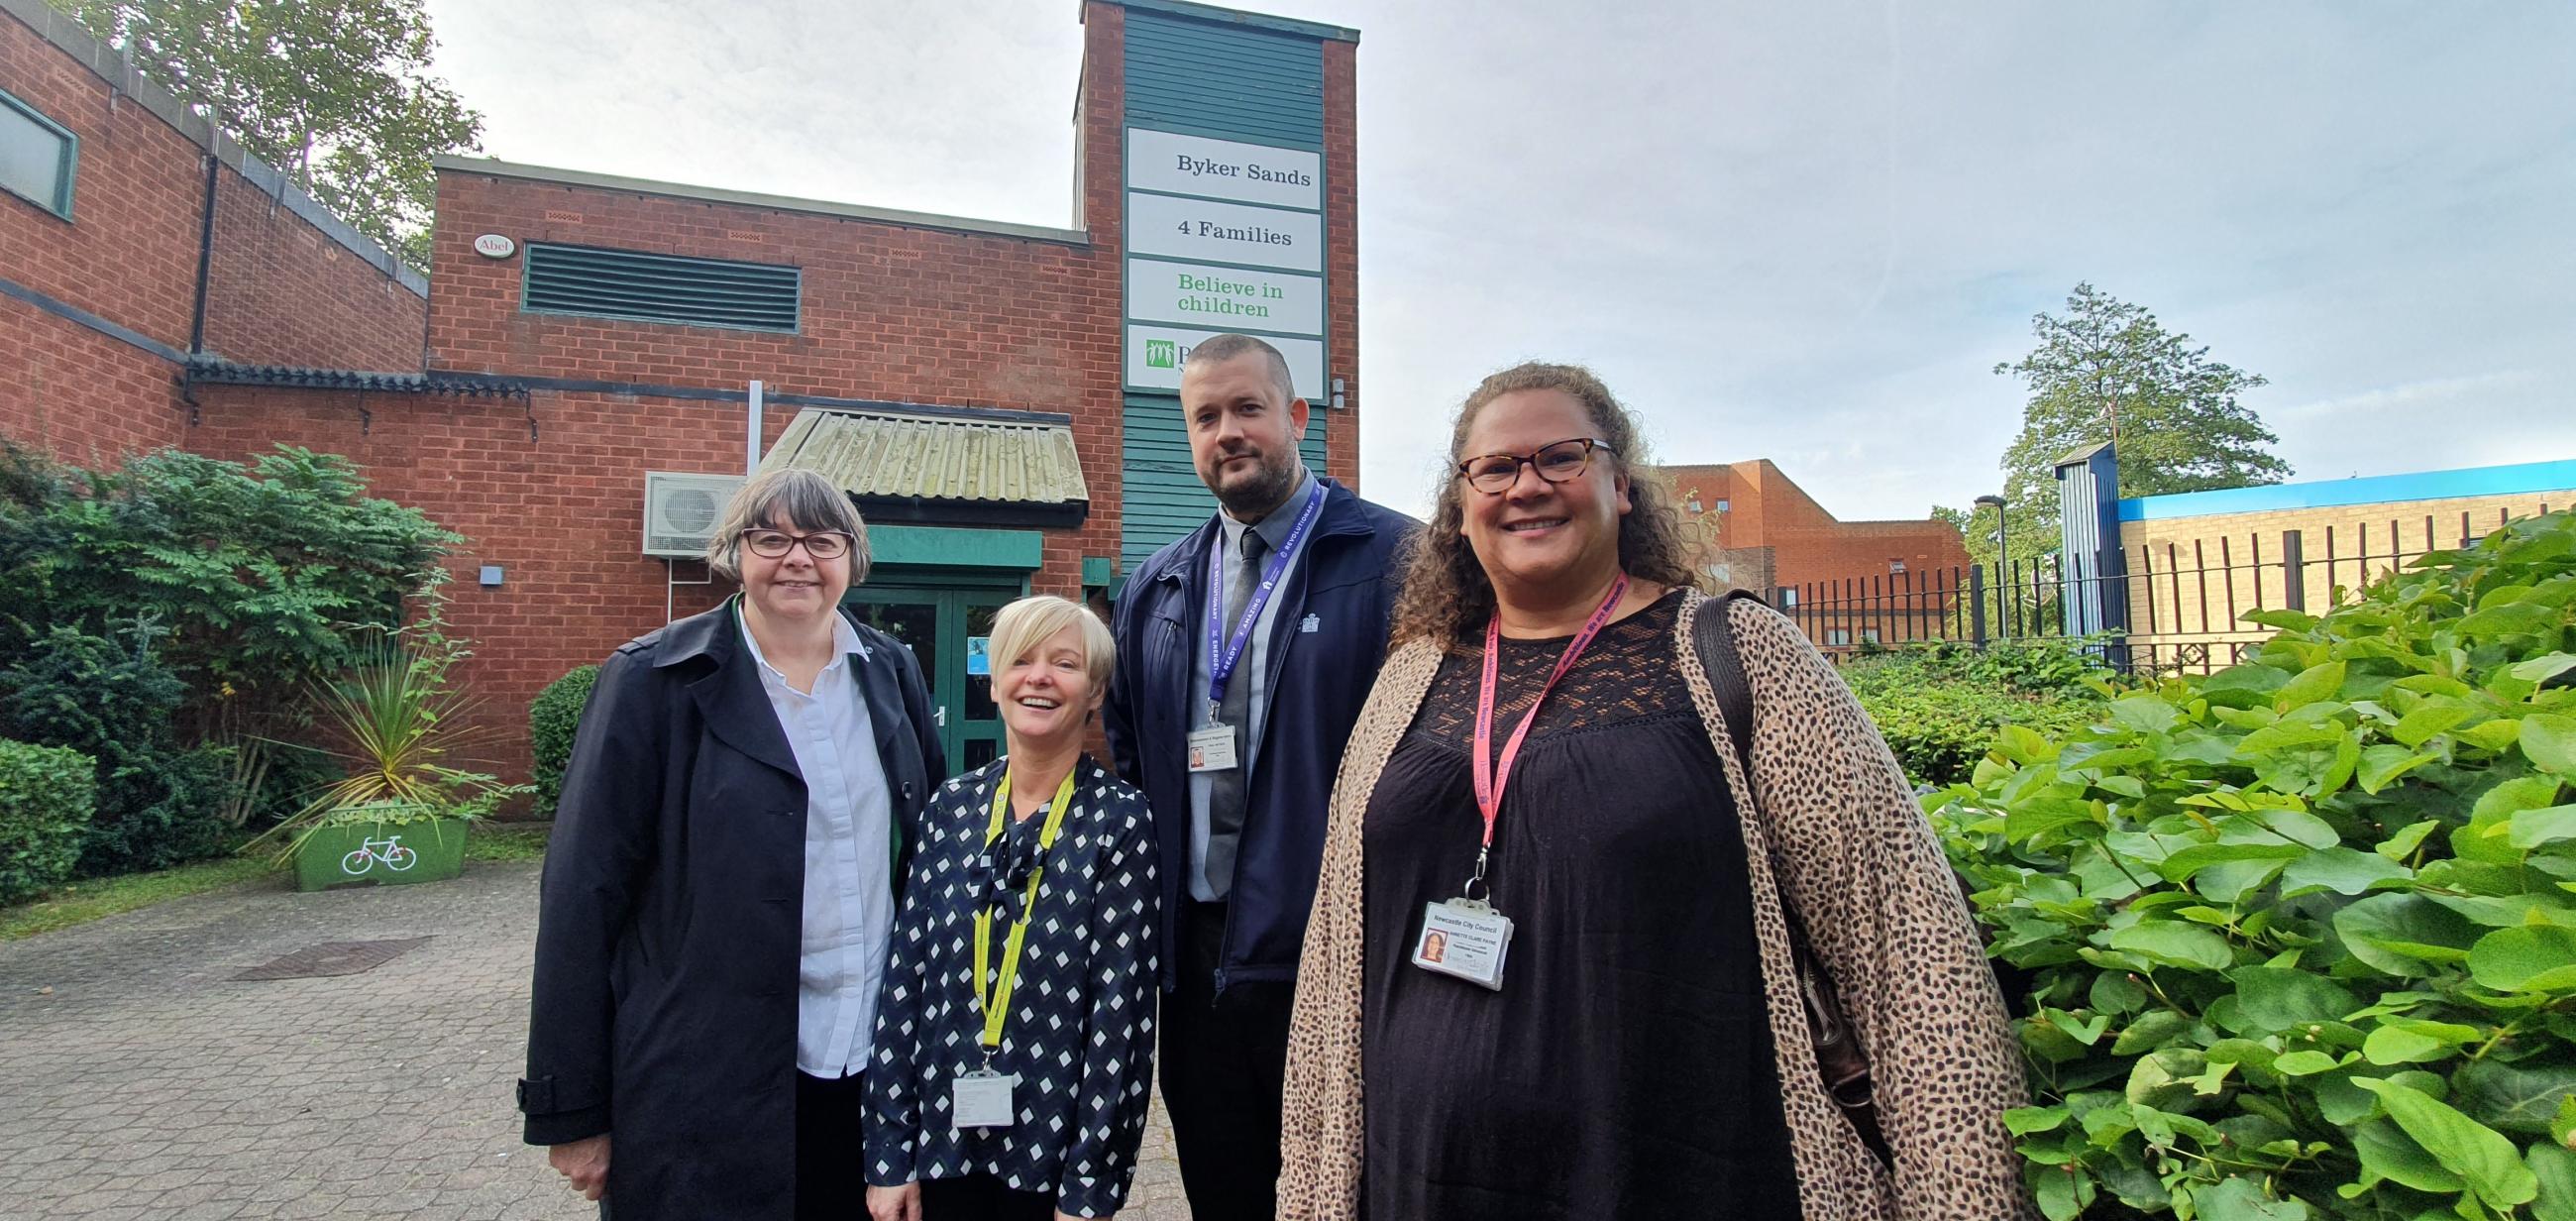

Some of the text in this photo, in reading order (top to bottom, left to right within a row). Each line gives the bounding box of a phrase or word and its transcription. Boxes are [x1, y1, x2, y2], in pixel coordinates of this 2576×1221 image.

[1177, 154, 1312, 186] Byker Sands
[481, 239, 509, 252] Abel
[1177, 220, 1293, 246] 4 Families
[1177, 274, 1284, 299] Believe in
[1177, 291, 1270, 318] children
[1284, 500, 1315, 551] REVOLUTIONARY
[1602, 581, 1625, 613] Newcastle
[1242, 598, 1261, 629] AMAZING
[1223, 645, 1237, 671] READY
[1434, 914, 1498, 934] Newcastle City Council
